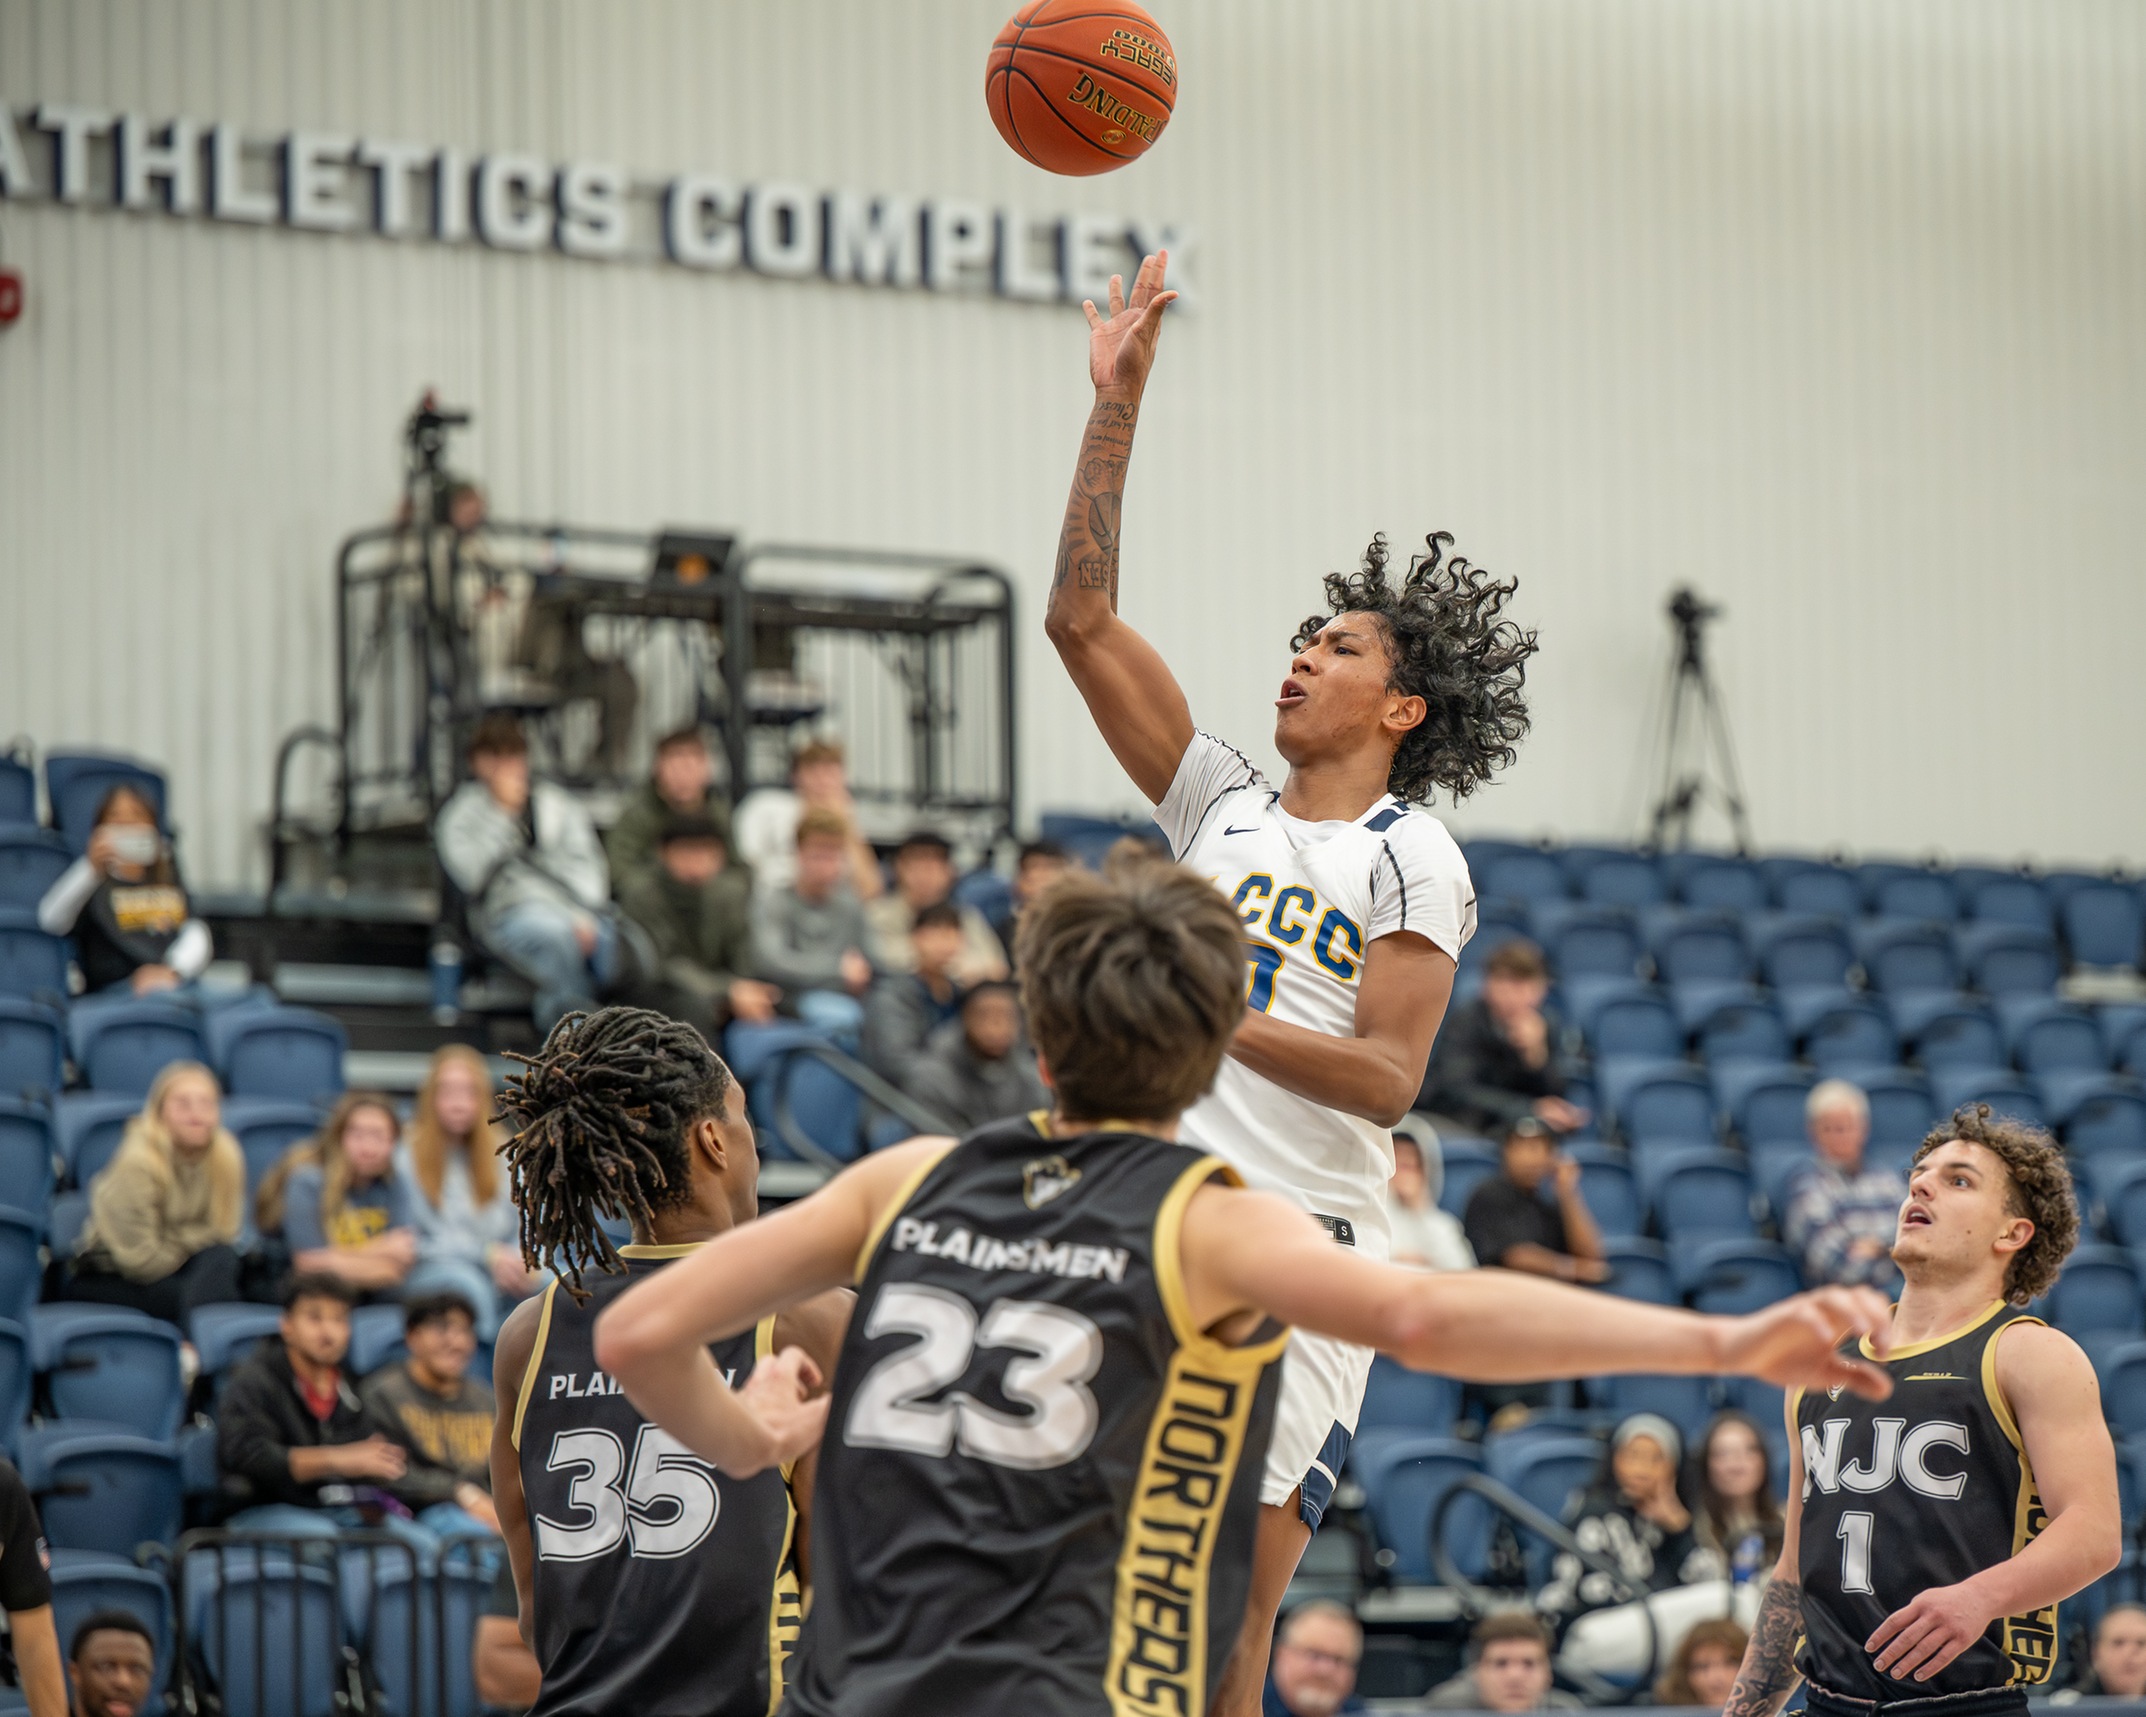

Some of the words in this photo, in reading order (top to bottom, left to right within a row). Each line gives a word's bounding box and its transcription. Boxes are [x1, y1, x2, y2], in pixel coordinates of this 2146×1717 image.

[664, 173, 1196, 312] COMPLEX
[1207, 872, 1364, 982] CCC
[891, 1216, 1130, 1284] PLAINSMEN
[843, 1282, 1104, 1471] 23
[536, 1422, 720, 1562] 35
[1800, 1417, 1970, 1503] NJC
[1120, 1369, 1240, 1717] NORTHEAS
[1836, 1510, 1875, 1596] 1
